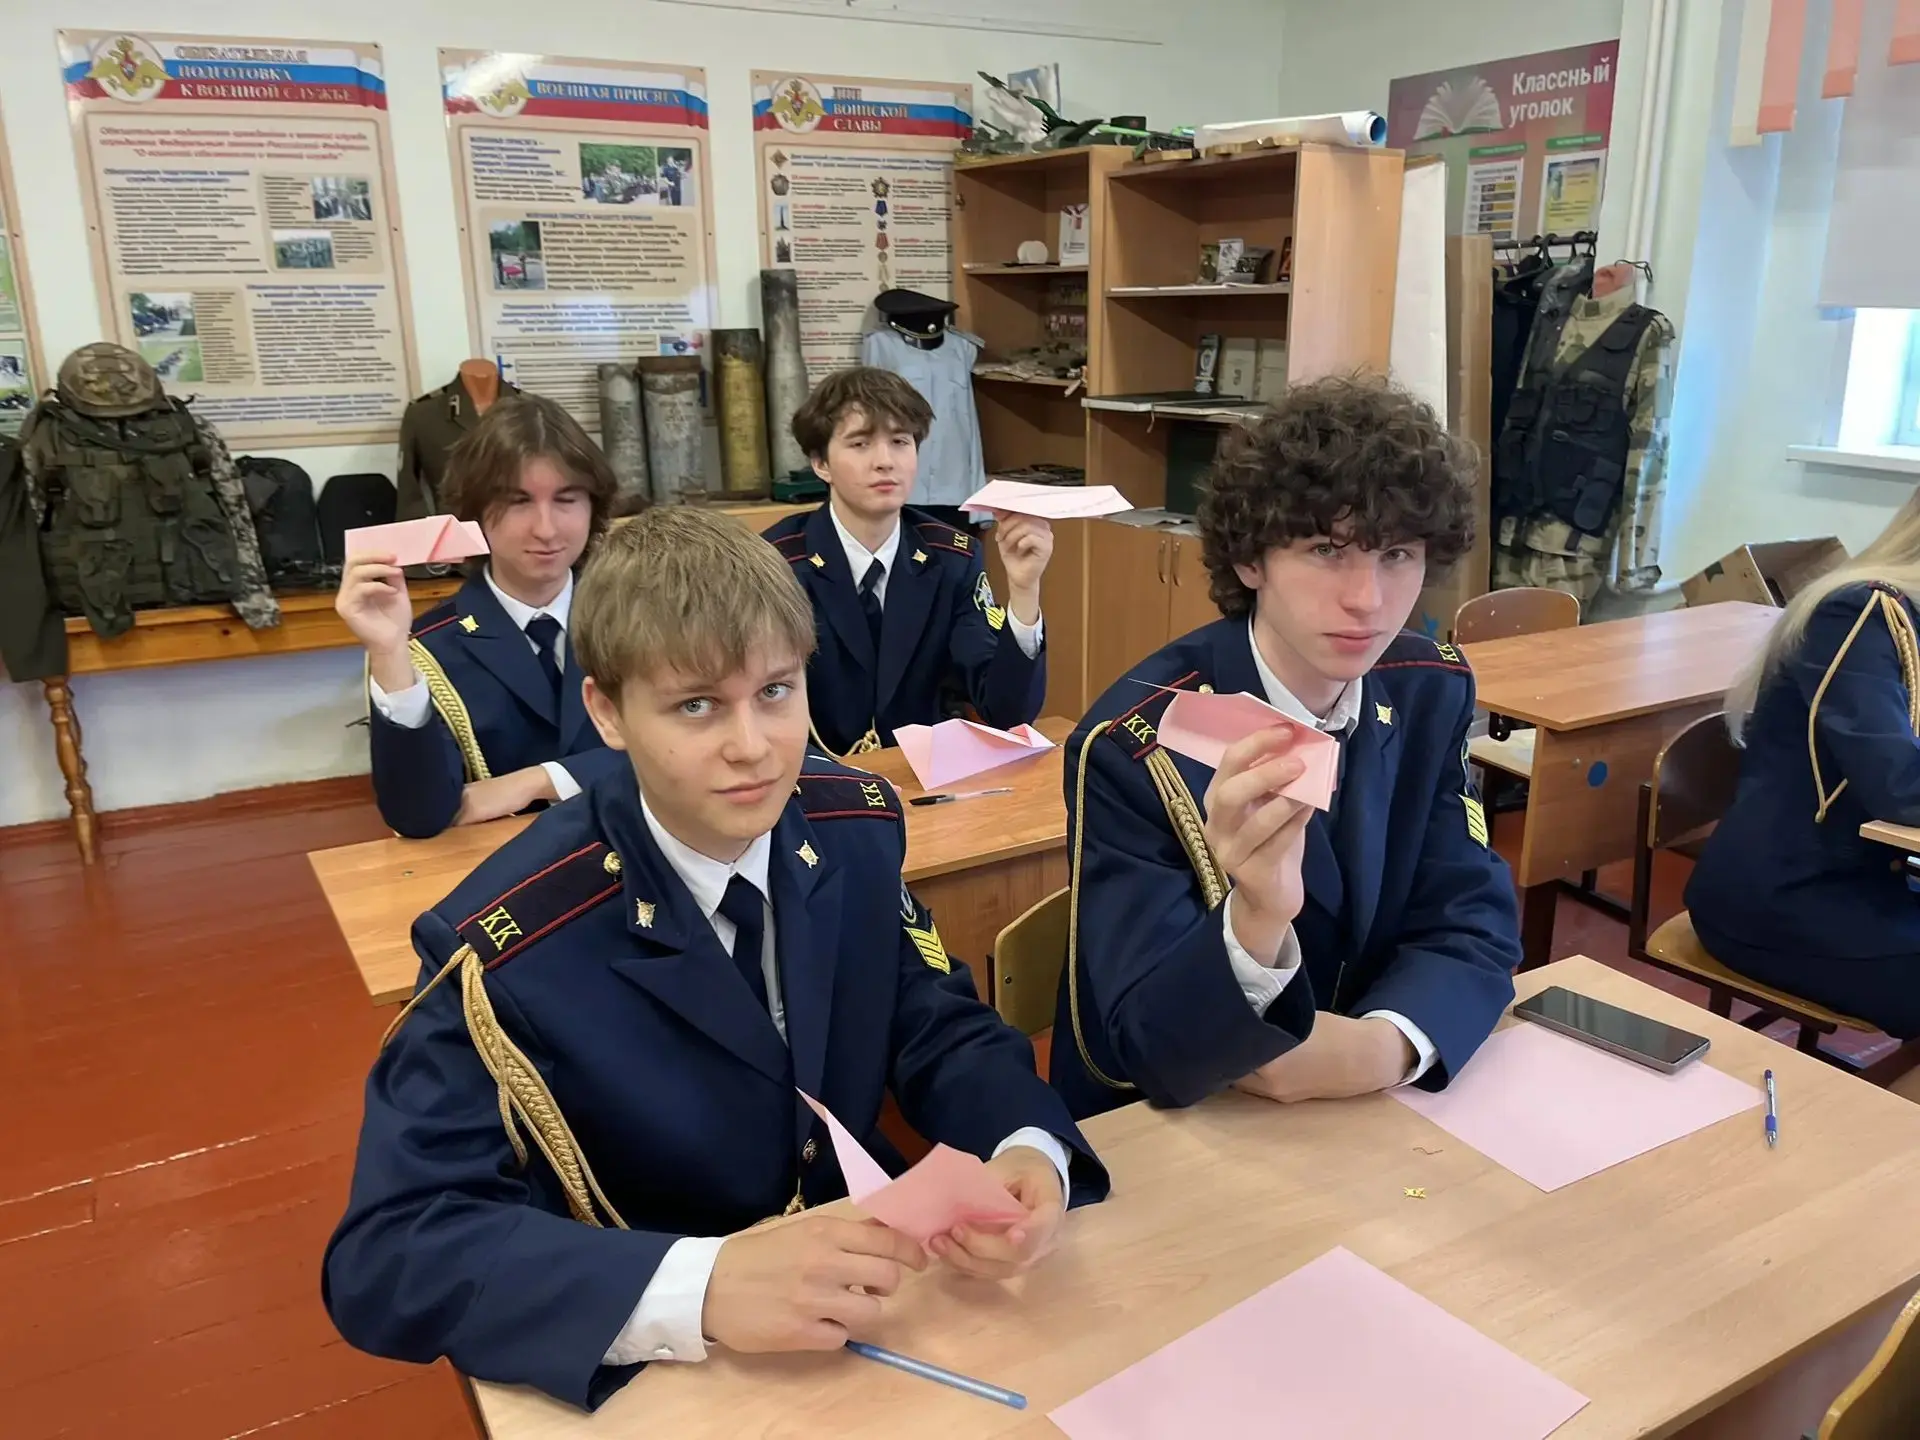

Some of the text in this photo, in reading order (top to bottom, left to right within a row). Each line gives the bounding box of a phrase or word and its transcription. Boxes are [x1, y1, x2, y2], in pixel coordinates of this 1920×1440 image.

[178, 64, 293, 81] ПОДГОТОВКА
[1512, 56, 1610, 96] Классный
[180, 81, 351, 101] К ВОЕННОЙ СЛУЖБЕ
[536, 82, 680, 105] ВОЕННАЯ ПРИСЯГА
[1508, 97, 1574, 128] уголок
[833, 118, 882, 132] СЛАВЫ
